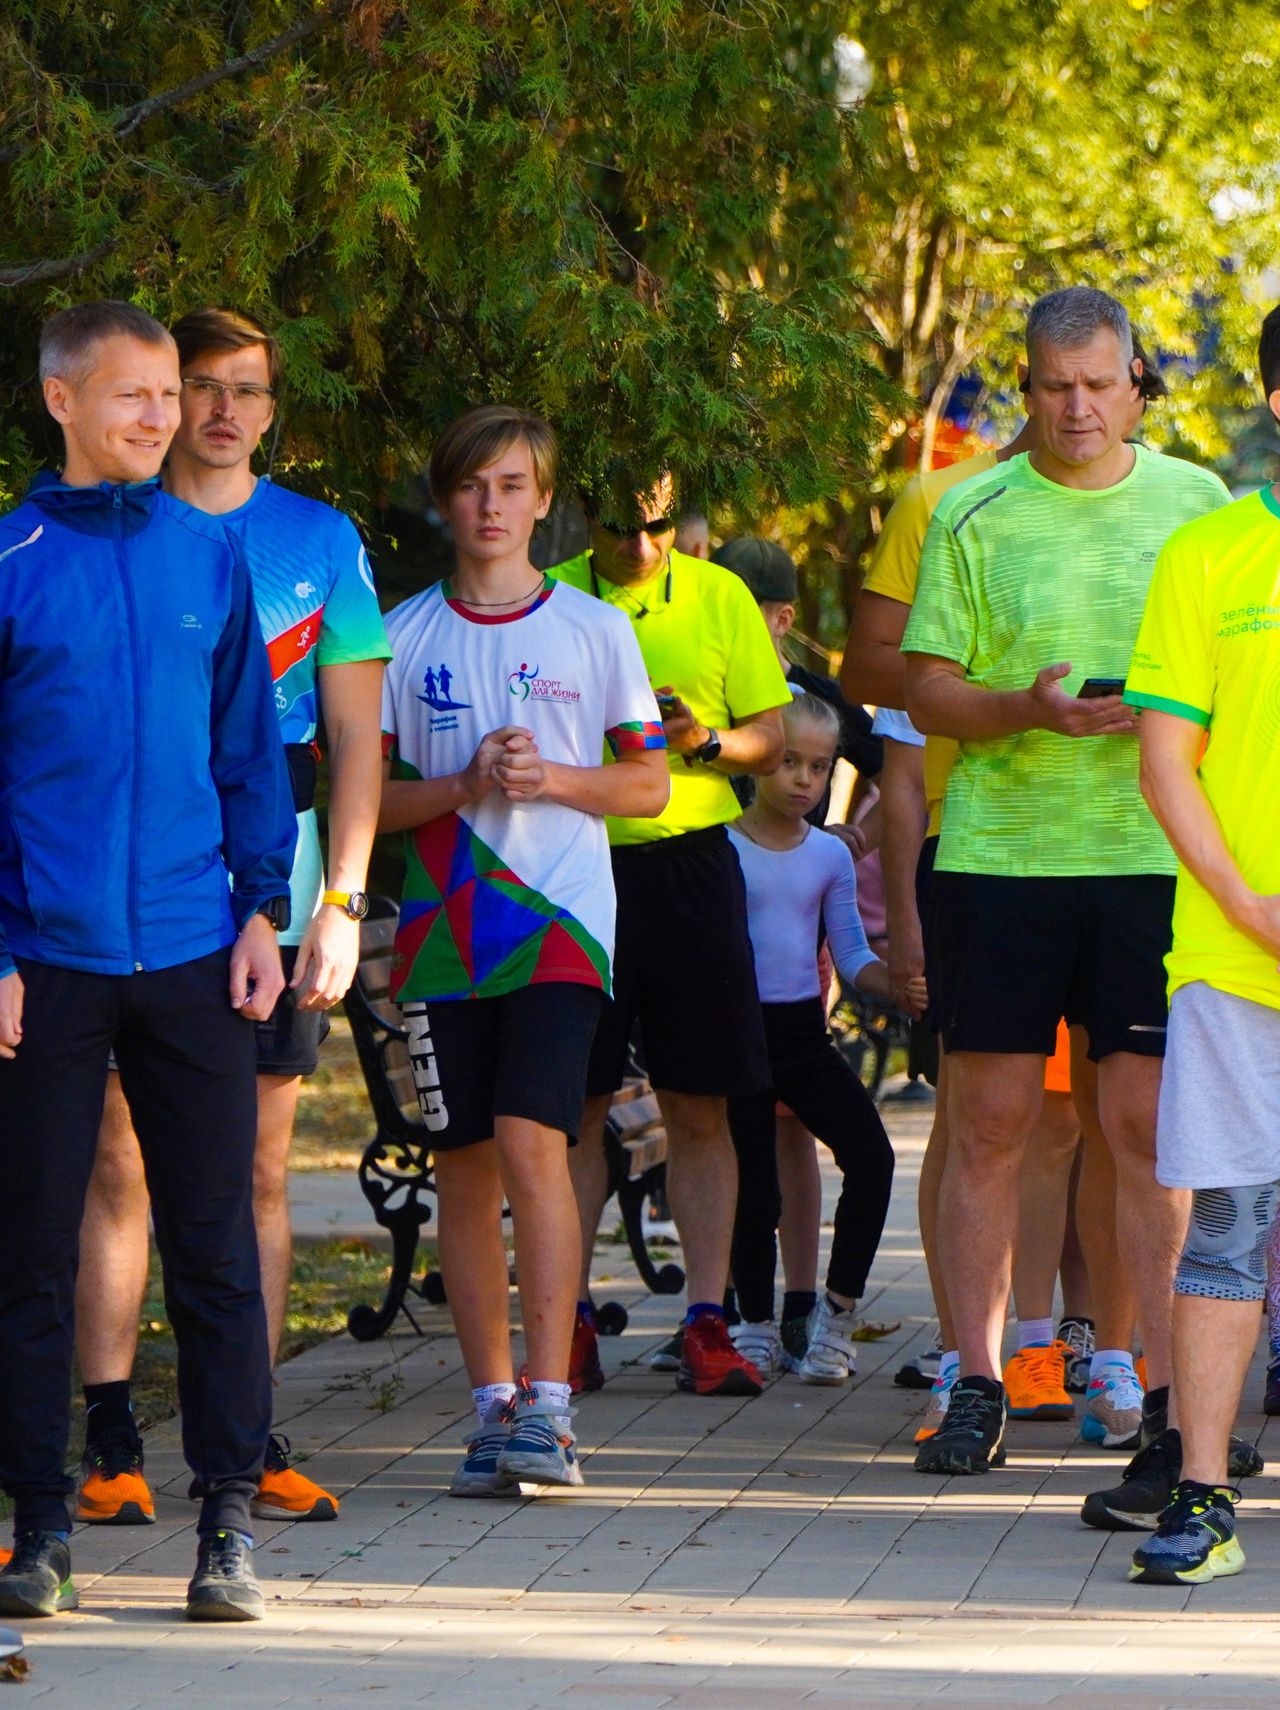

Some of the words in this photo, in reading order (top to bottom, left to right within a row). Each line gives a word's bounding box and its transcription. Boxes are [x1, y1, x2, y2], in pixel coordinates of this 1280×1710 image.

[531, 678, 562, 689] СПОРТ
[531, 687, 548, 696] ДЛЯ
[551, 688, 581, 701] ЖИЗНИ
